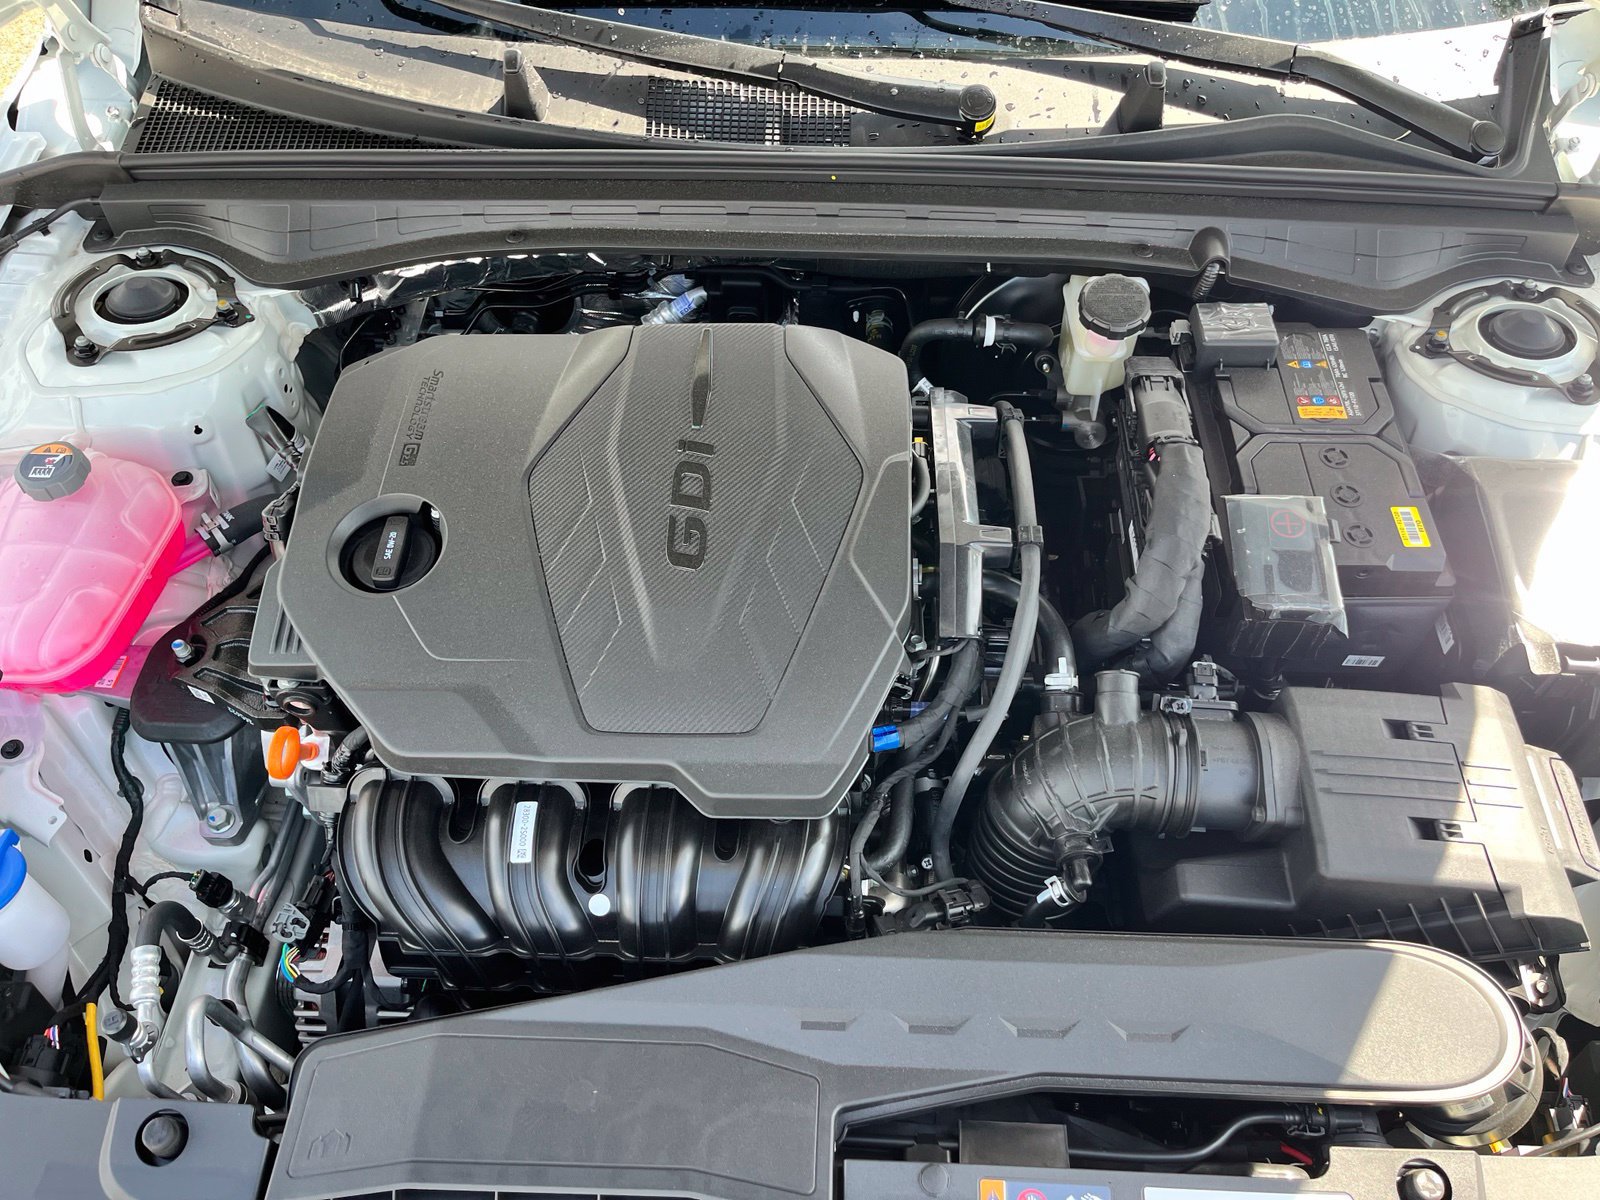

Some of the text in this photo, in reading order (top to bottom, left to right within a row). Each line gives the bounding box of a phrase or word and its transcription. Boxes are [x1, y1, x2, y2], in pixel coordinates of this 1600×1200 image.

[406, 375, 430, 441] TECHNOLOGY
[414, 368, 444, 441] Smartstream
[383, 531, 397, 560] SAE 0W-20
